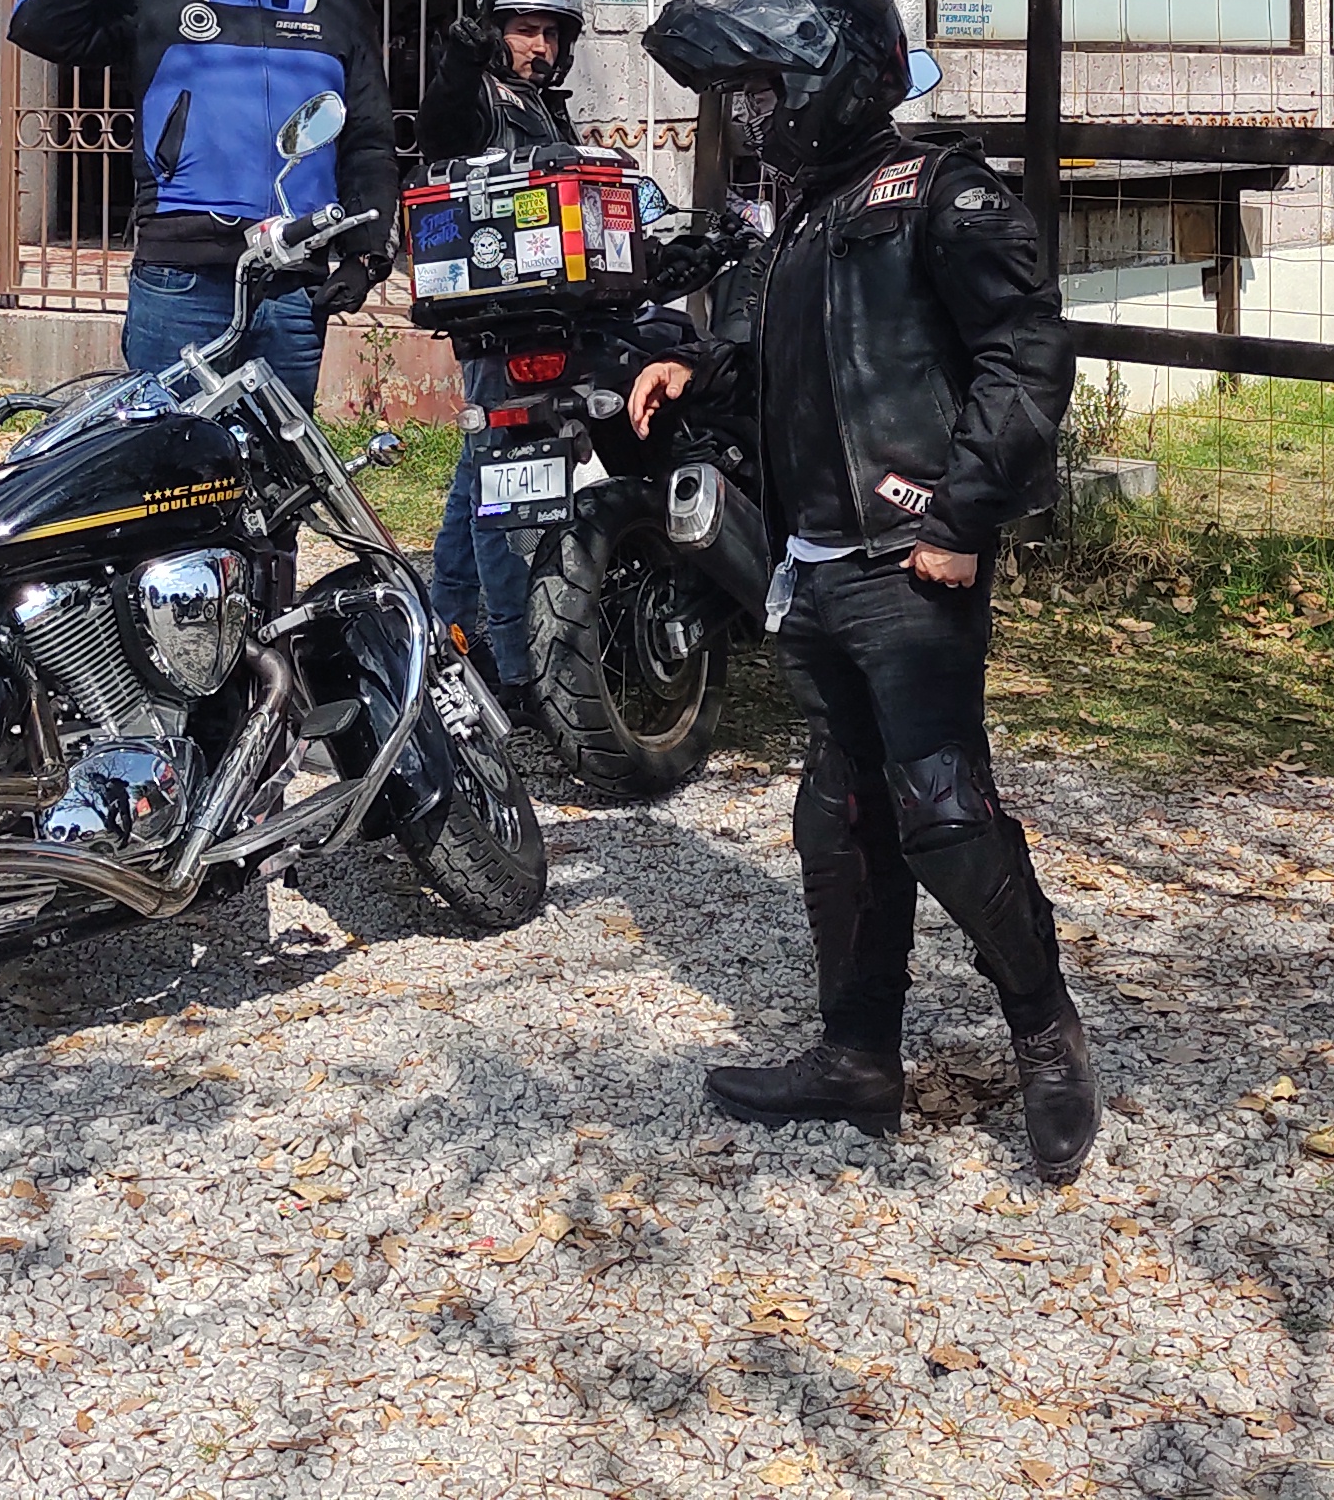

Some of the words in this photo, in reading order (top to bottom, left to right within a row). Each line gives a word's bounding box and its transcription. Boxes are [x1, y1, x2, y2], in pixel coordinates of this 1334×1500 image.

[871, 181, 914, 201] ELIOT
[417, 267, 437, 276] Viva
[522, 256, 559, 268] huasteca
[494, 463, 552, 497] 7F4LT
[149, 490, 234, 515] BOULEVARD
